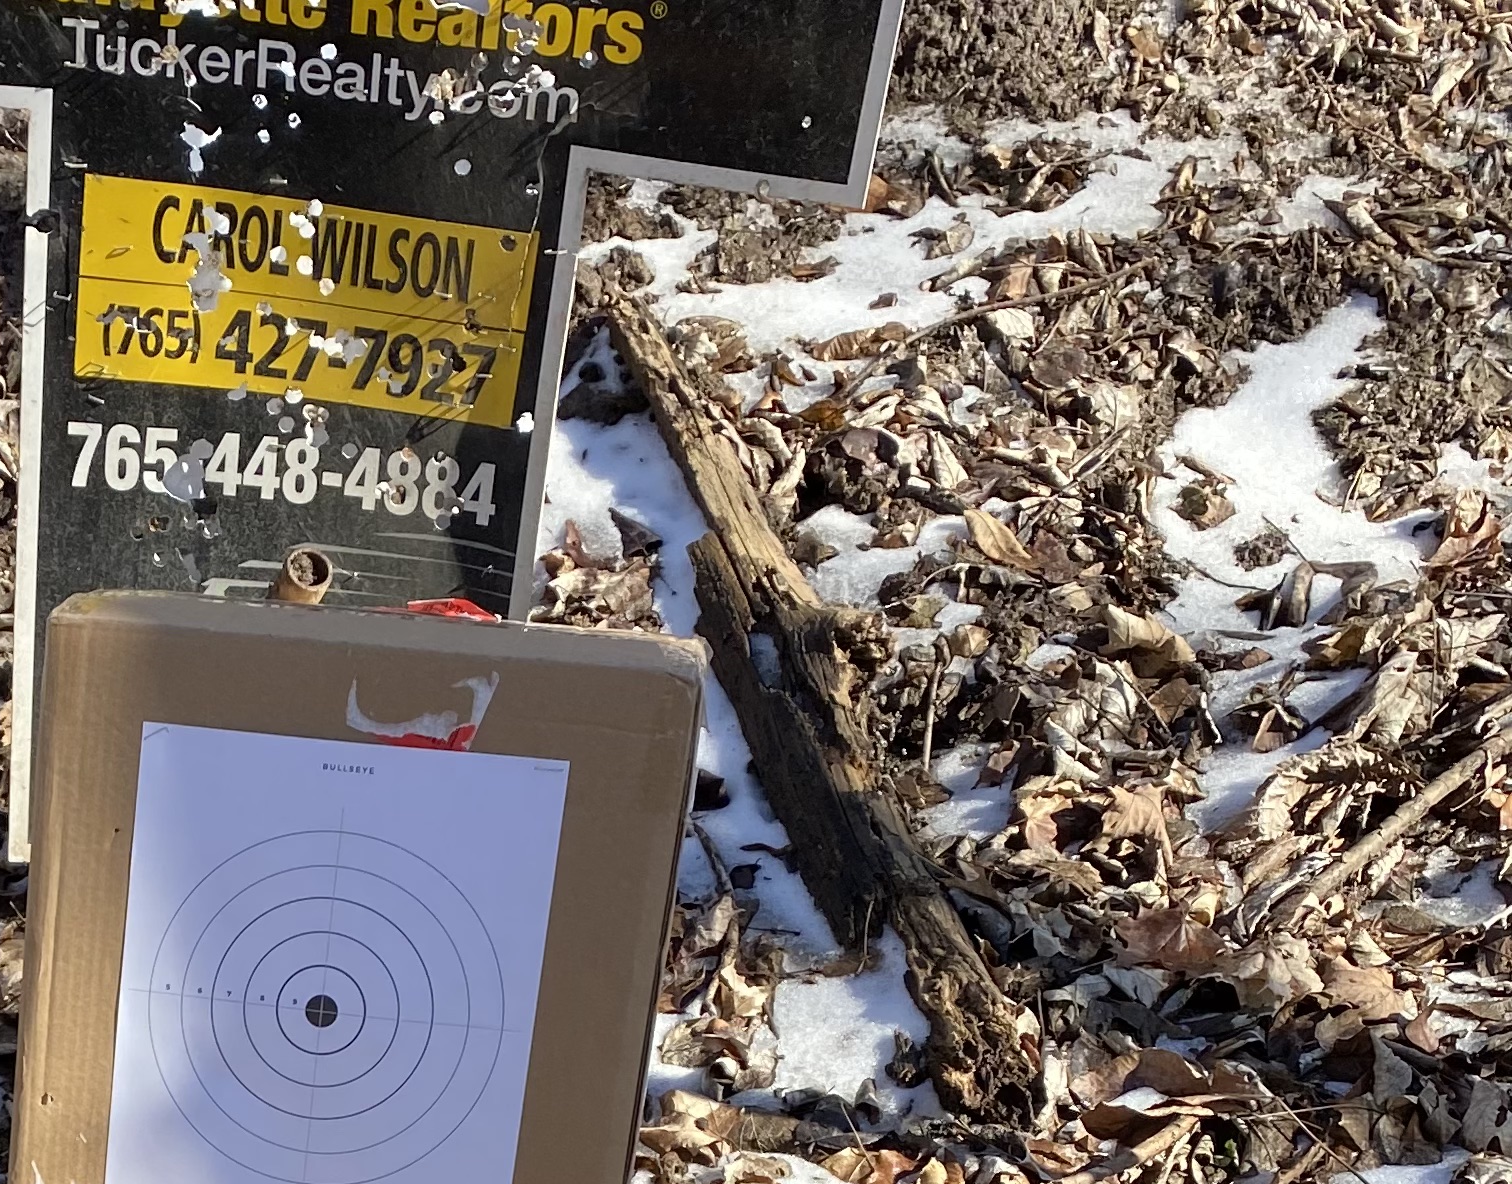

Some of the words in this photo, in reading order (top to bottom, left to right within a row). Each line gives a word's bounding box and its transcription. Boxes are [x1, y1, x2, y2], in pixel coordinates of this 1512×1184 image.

[152, 194, 289, 277] CAROL
[311, 217, 476, 304] WILSON
[100, 303, 201, 364] (765)
[215, 309, 498, 407] 427-7927
[322, 763, 375, 775] BULLSEYE
